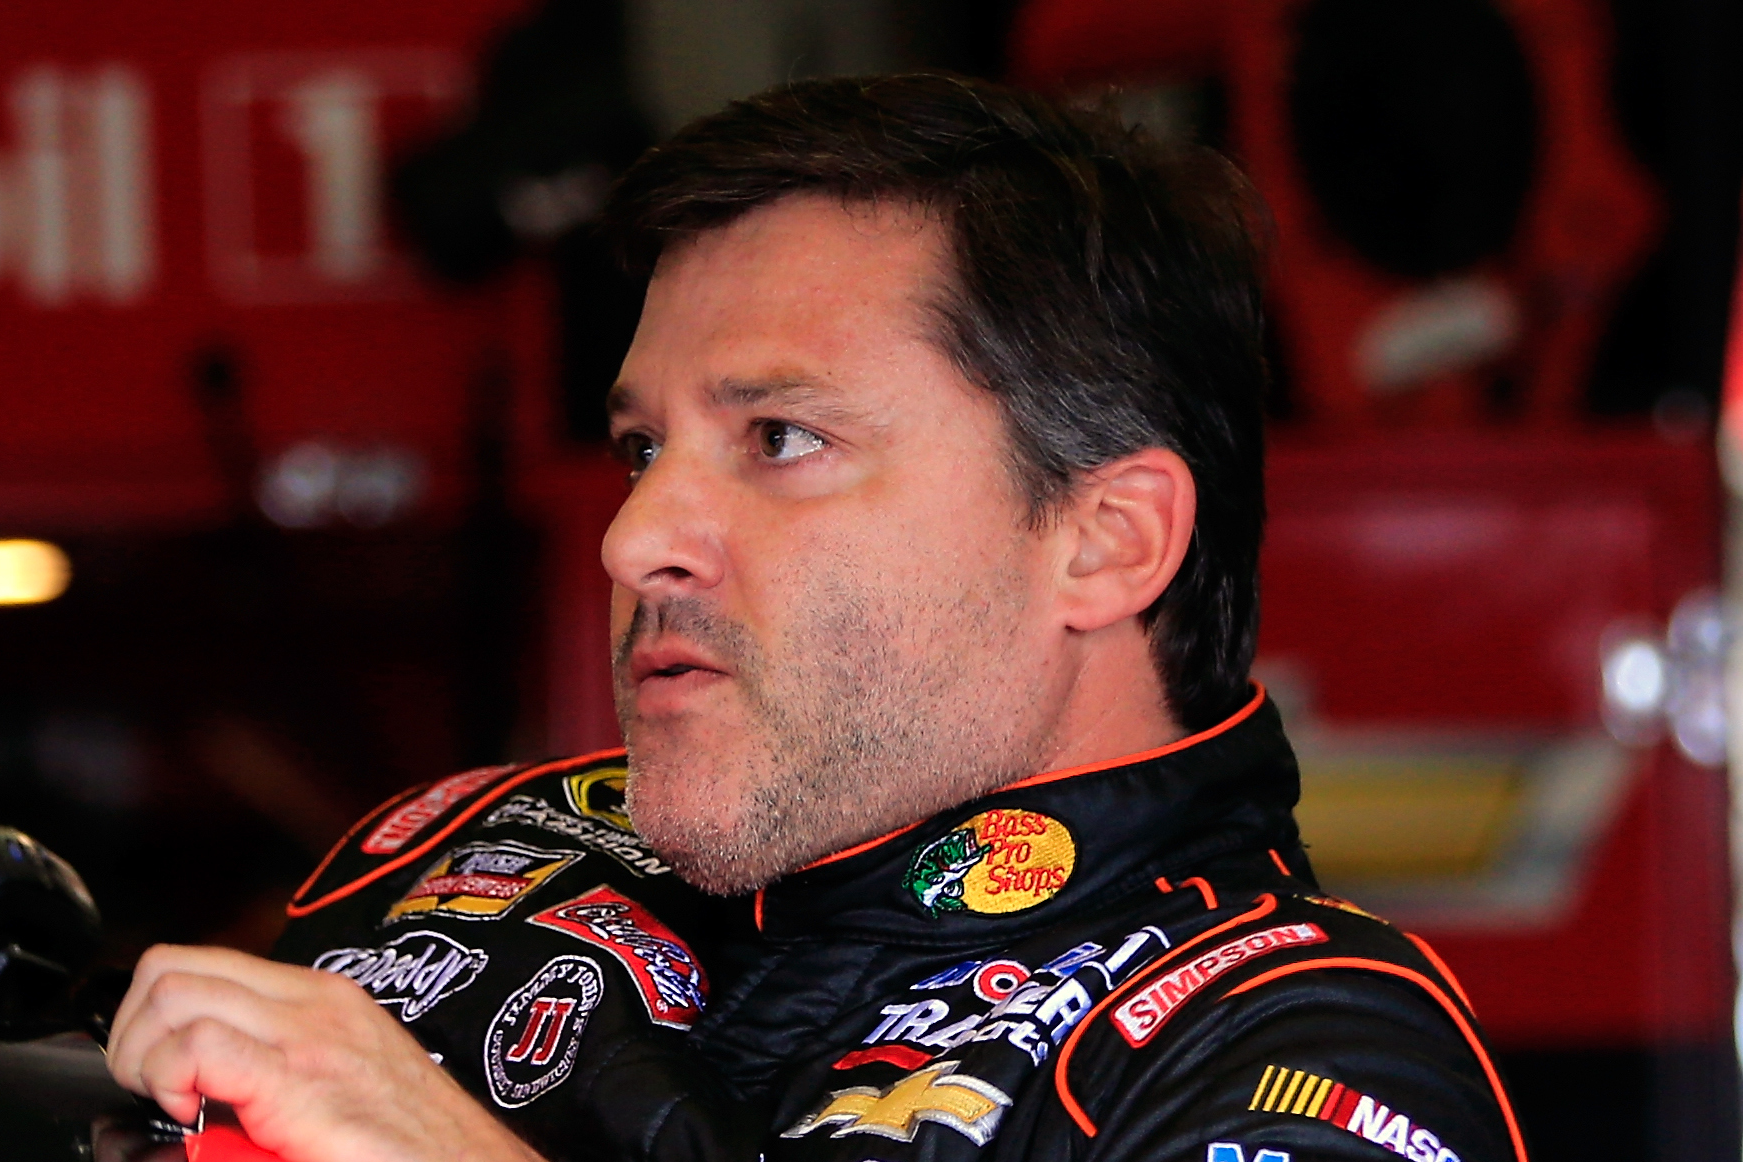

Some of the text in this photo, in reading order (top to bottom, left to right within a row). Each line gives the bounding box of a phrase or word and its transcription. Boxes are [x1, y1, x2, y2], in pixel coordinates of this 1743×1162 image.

[981, 809, 1046, 840] Bass
[986, 839, 1031, 865] Pro
[986, 864, 1065, 899] Shops
[1128, 928, 1301, 1029] SIMPSON
